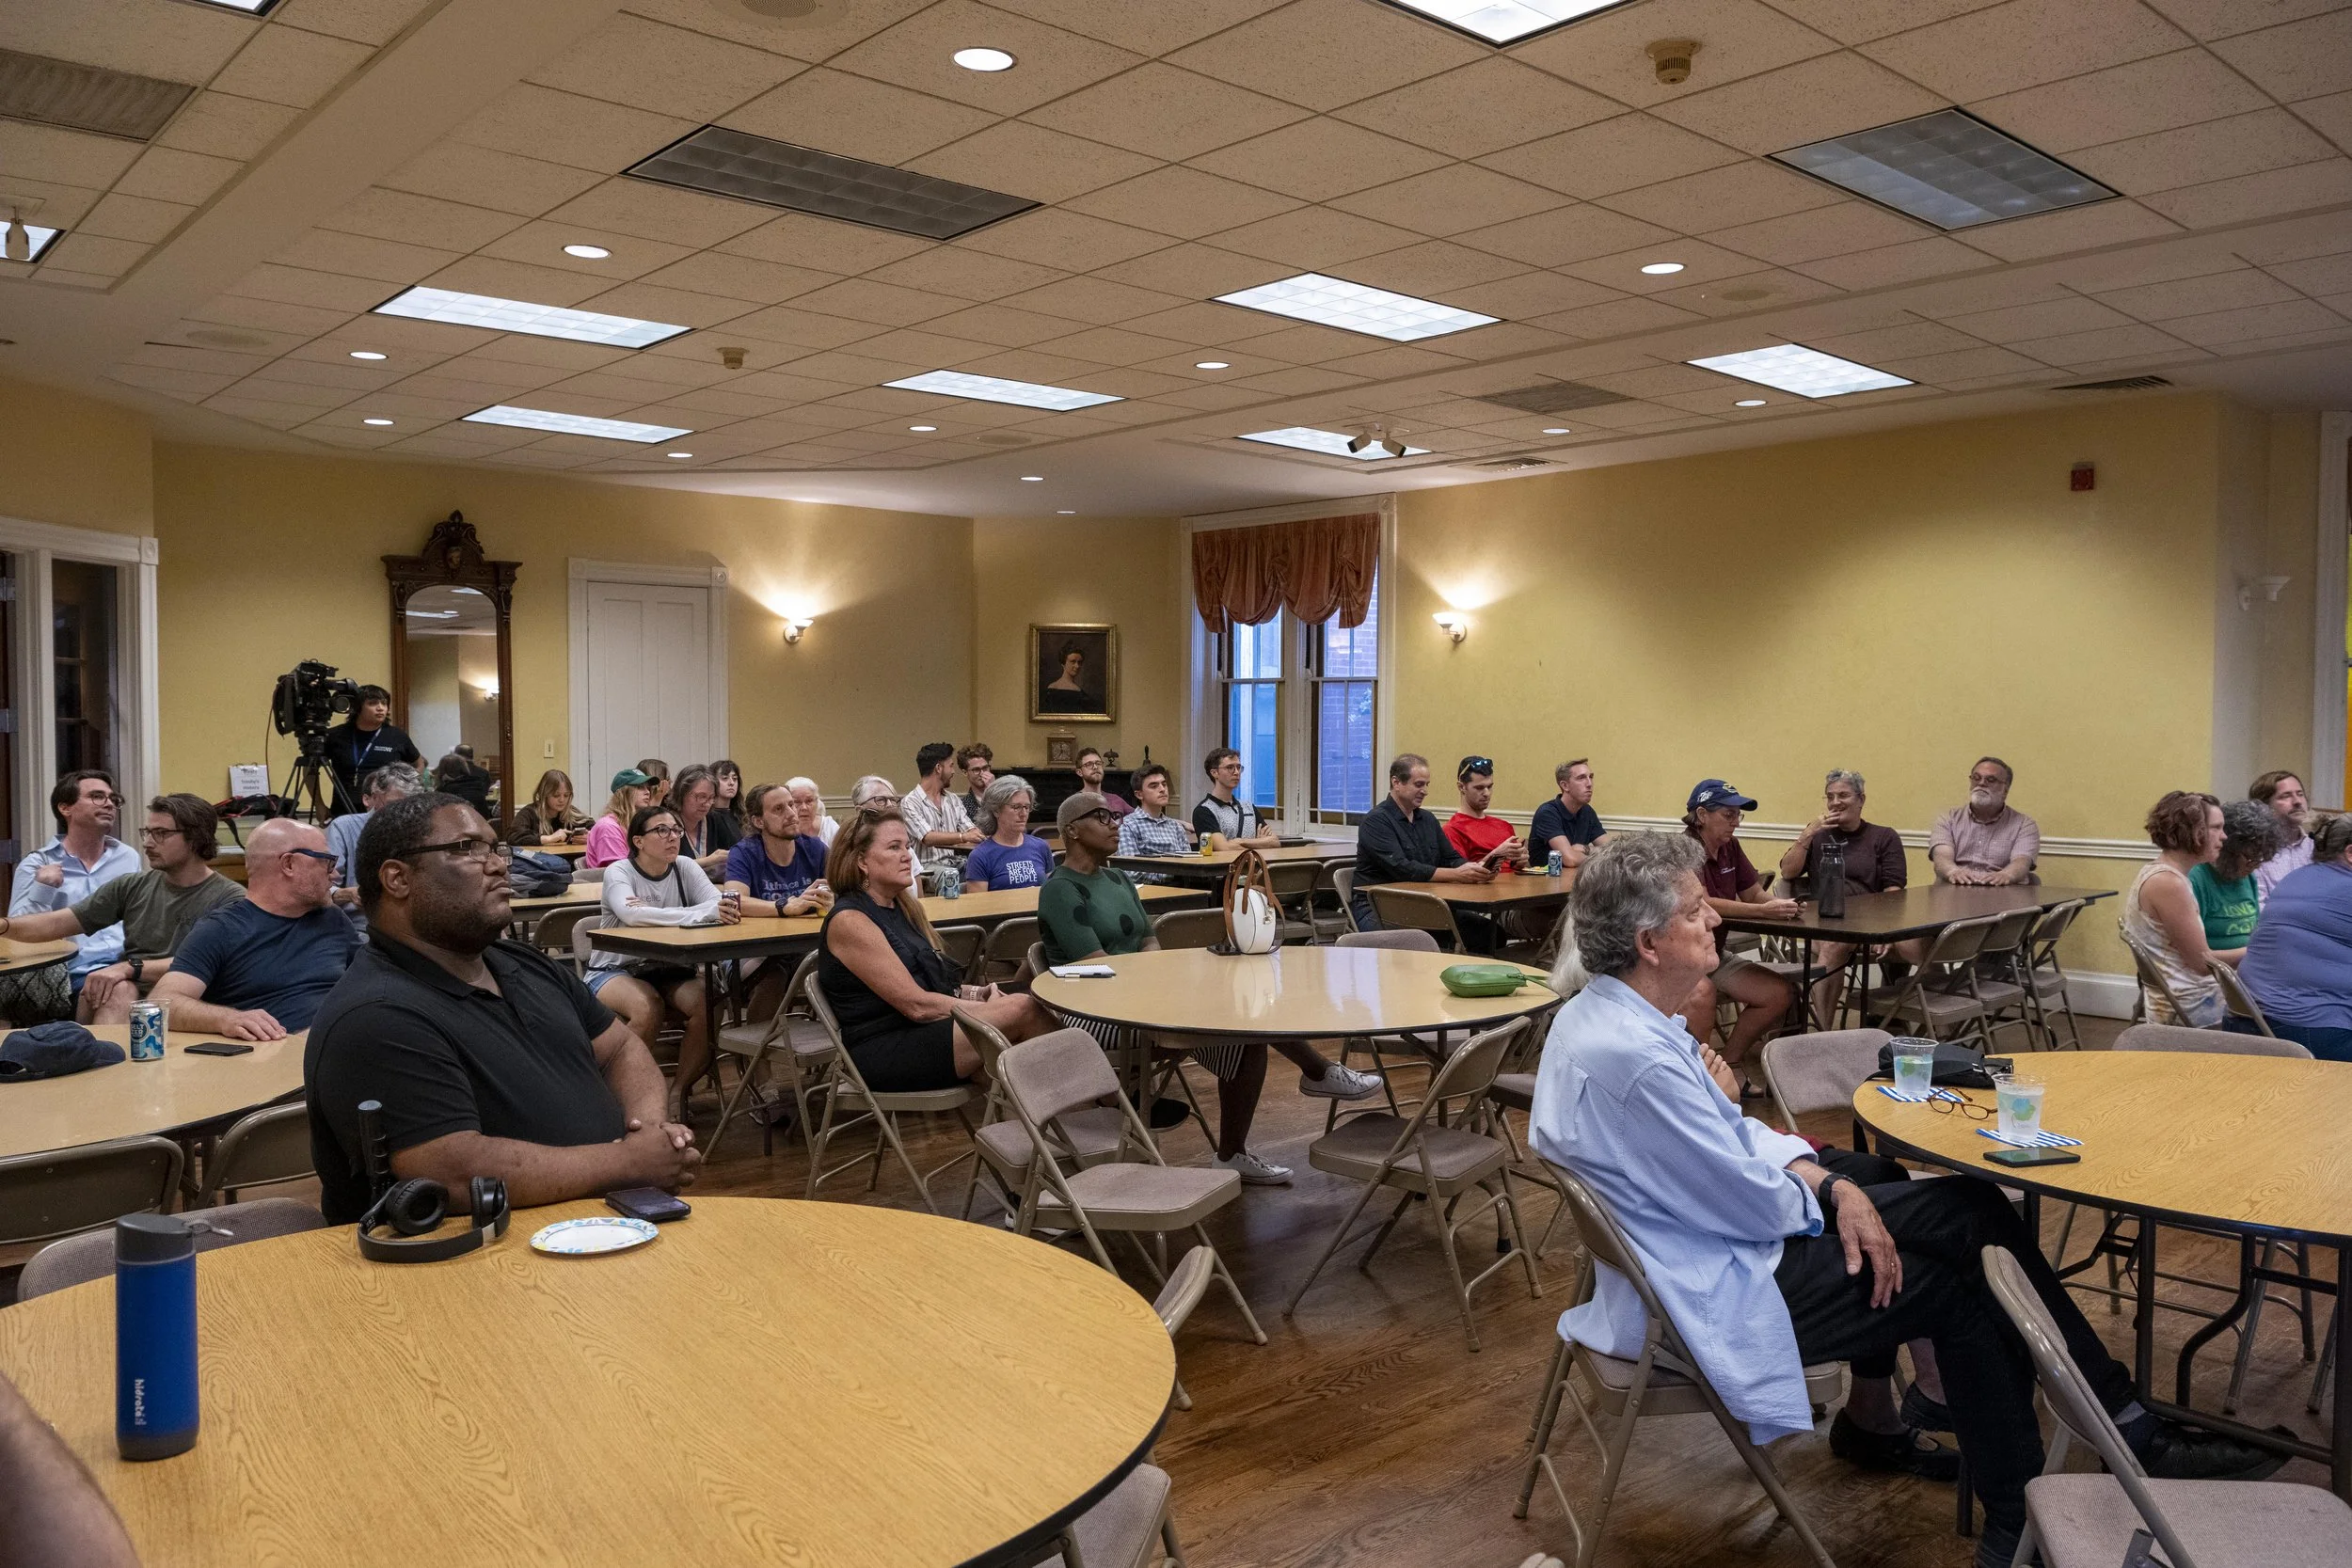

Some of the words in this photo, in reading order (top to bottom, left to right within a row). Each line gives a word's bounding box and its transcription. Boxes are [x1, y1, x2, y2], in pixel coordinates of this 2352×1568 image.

[1007, 861, 1034, 870] STREETS
[802, 877, 812, 885] is
[1009, 874, 1038, 884] PEOPLE
[2223, 900, 2256, 917] LOVE
